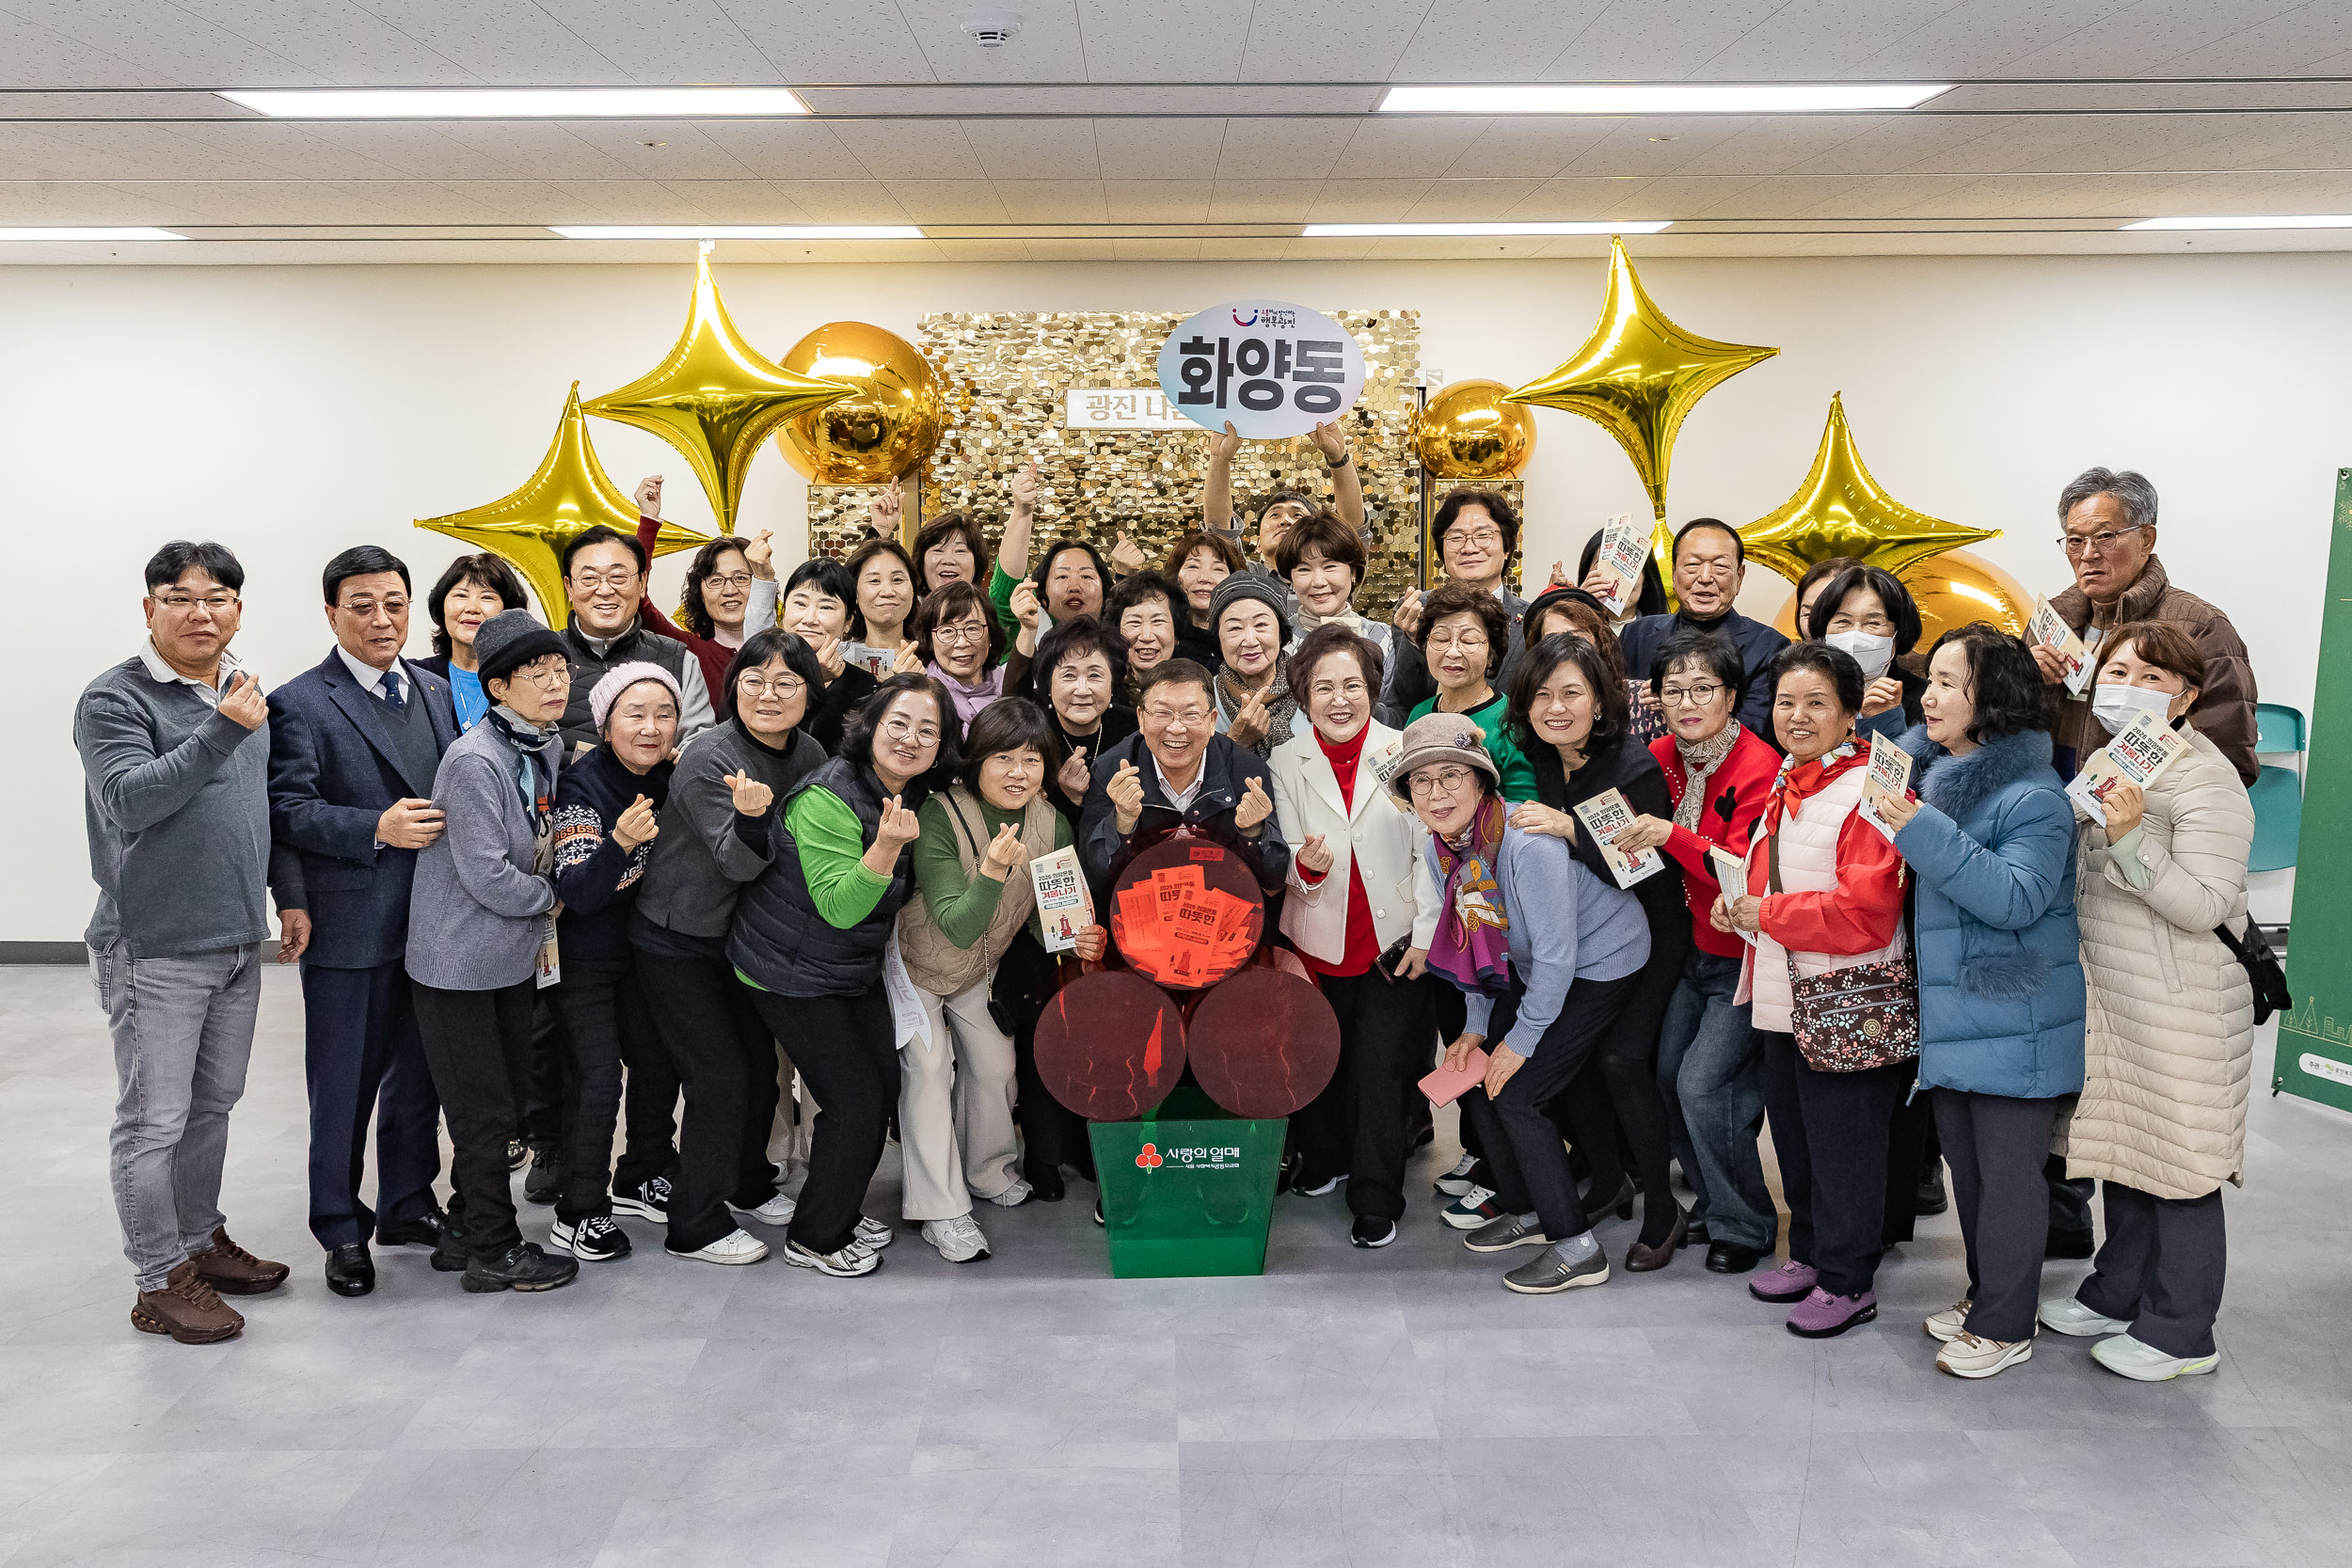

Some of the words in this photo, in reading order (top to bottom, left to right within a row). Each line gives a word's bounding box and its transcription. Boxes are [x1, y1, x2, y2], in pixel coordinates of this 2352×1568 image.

[1261, 315, 1295, 328] 행복광진
[1178, 335, 1346, 414] 화양동
[1086, 394, 1136, 421] 광진
[1145, 394, 1191, 420] 나
[1605, 531, 1618, 544] 따뜻
[1614, 550, 1639, 571] 겨울나기
[1617, 541, 1643, 563] 따뜻한
[2123, 731, 2164, 767] 따뜻한
[2133, 726, 2148, 740] 2026
[2146, 738, 2169, 758] 희망온돌
[1874, 752, 1904, 783] 따뜻한
[2117, 740, 2154, 774] 겨울나기
[1873, 762, 1901, 790] 겨울나기
[1590, 808, 1626, 830] 따뜻한
[1596, 817, 1629, 836] 겨울나기
[1039, 876, 1075, 892] 따뜻한
[1052, 869, 1073, 879] 희망온돌
[1041, 886, 1077, 900] 겨울나기
[1160, 890, 1181, 901] 따뜻
[1180, 908, 1216, 927] 따뜻한
[1166, 1147, 1207, 1164] 사랑의
[1209, 1147, 1240, 1163] 열매
